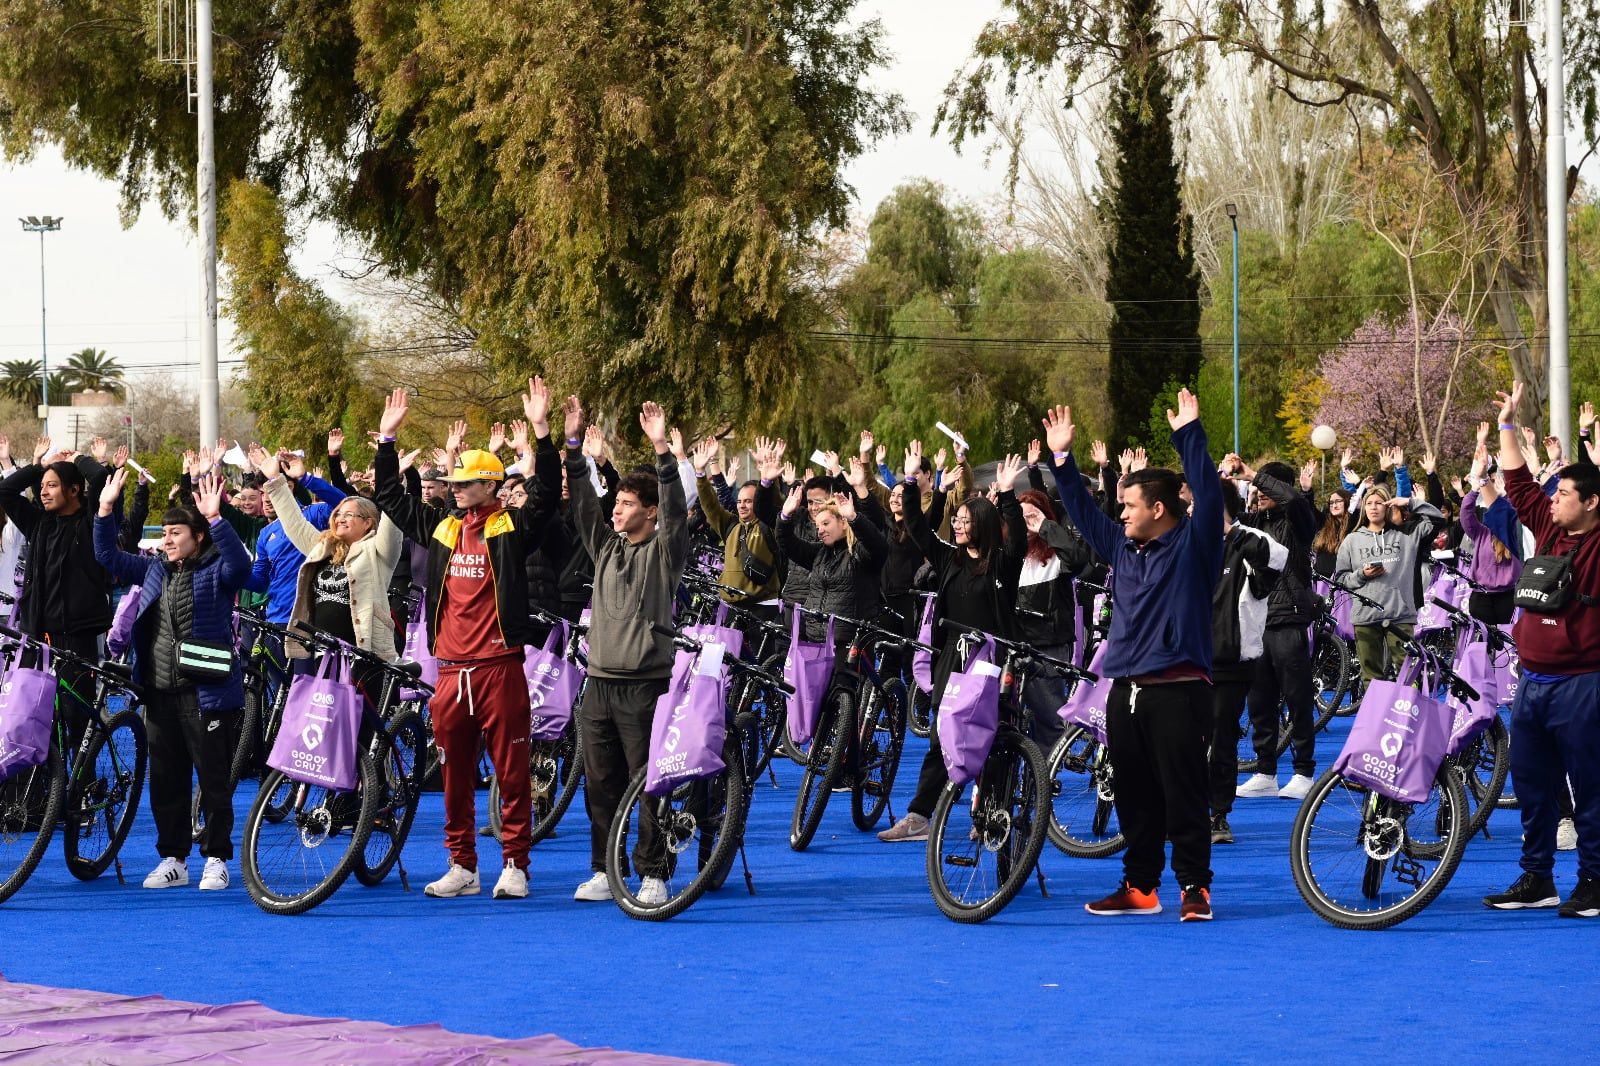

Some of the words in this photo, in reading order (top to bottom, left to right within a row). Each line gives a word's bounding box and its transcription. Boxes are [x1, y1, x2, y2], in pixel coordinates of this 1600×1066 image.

[1359, 541, 1400, 560] BOSS
[451, 553, 485, 565] RKISH
[450, 565, 485, 578] RLINES
[1516, 588, 1549, 603] LACOSTE
[291, 750, 328, 765] GODOY
[655, 751, 688, 768] GODOY
[1362, 752, 1404, 775] GODOY
[294, 759, 323, 773] CRUZ
[659, 761, 687, 775] CRUZ
[1364, 763, 1396, 783] CRUZ
